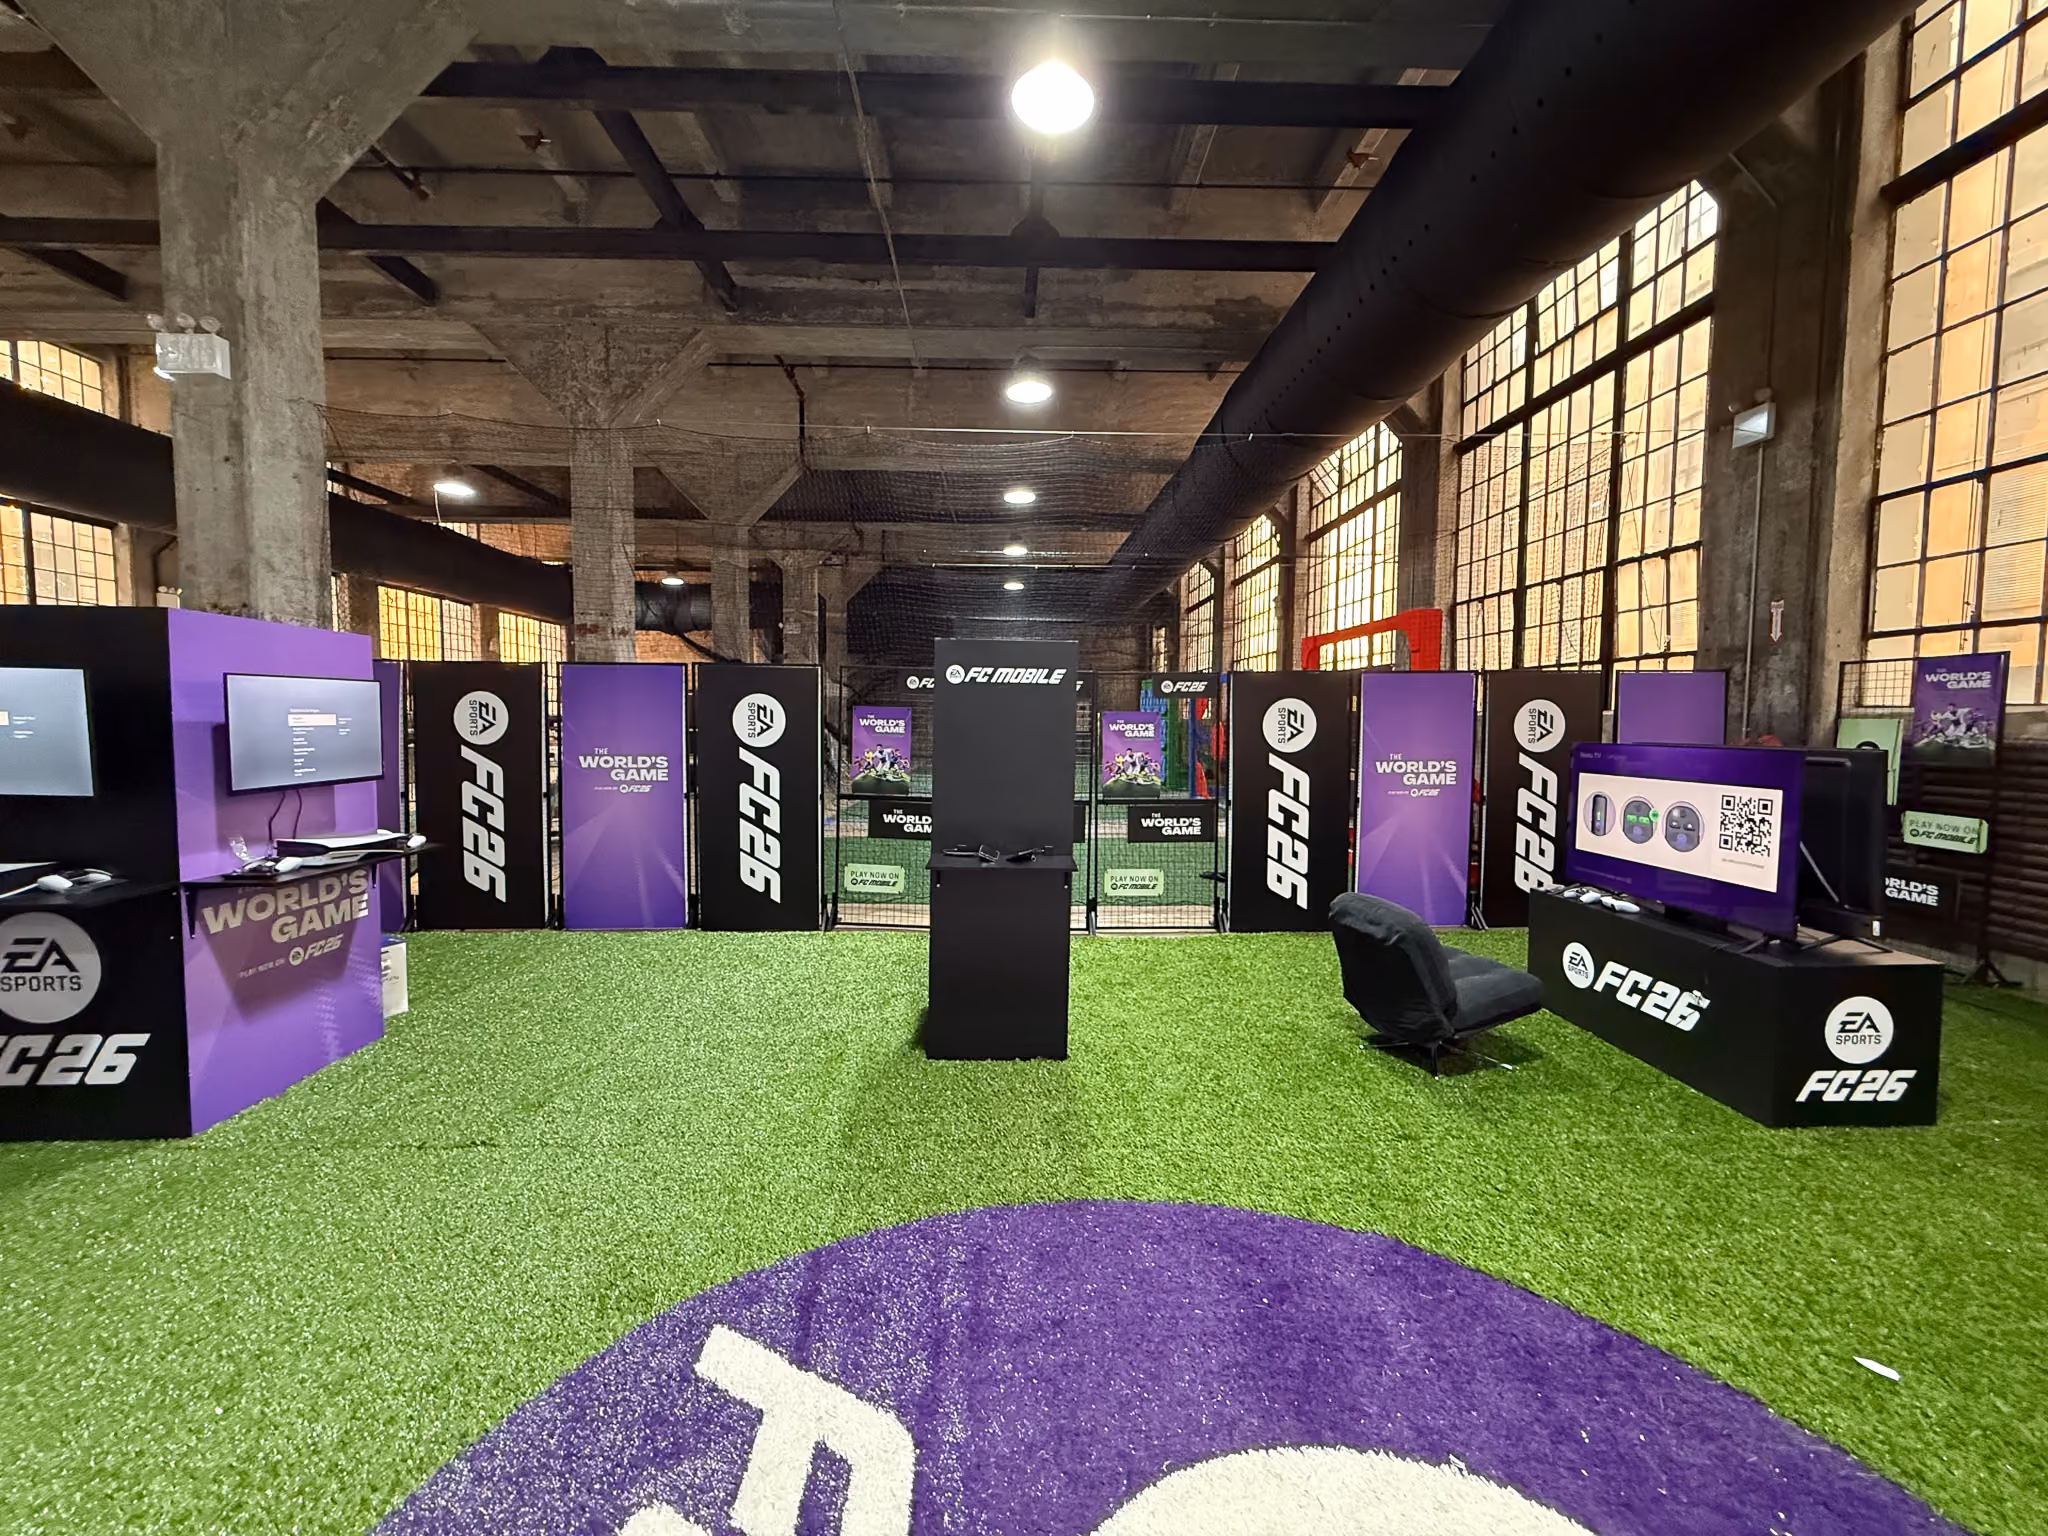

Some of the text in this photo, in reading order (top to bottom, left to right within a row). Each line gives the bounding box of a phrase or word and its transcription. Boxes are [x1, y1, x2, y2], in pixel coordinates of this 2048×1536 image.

[964, 667, 1067, 684] FC MOBILE
[1925, 672, 1992, 682] WORLD'S
[1173, 682, 1208, 692] FC26
[1946, 680, 1992, 689] GAME
[469, 700, 478, 736] SPORTS
[479, 701, 496, 735] EA
[748, 702, 756, 738] SPORTS
[757, 703, 774, 738] EA
[859, 719, 905, 727] WORLD'S
[1278, 708, 1286, 744] SPORTS
[1287, 708, 1304, 742] EA
[1528, 708, 1537, 744] SPORTS
[1537, 709, 1553, 742] EA
[874, 726, 905, 734] GAME
[1109, 723, 1155, 731] WORLD'S
[579, 756, 668, 768] WORLD'S
[1376, 761, 1456, 773] WORLD'S
[610, 768, 668, 781] GAME
[1403, 773, 1456, 785] GAME
[461, 744, 507, 903] FC26
[739, 746, 781, 904] FC26
[883, 814, 932, 824] WORLD
[1141, 818, 1201, 827] WORLD'S
[1909, 820, 1932, 829] PLAY
[1936, 823, 1960, 832] NOW
[1162, 826, 1201, 835] GAME
[1267, 752, 1310, 910] FC26
[1920, 831, 1935, 839] FC
[1885, 878, 1939, 895] RLD'S
[203, 869, 369, 934] WORLD'S
[1885, 888, 1938, 906] GAME
[271, 893, 369, 943] GAME
[1, 937, 80, 973] EA
[1568, 951, 1588, 971] EA
[1568, 964, 1589, 979] SPORTS
[0, 975, 82, 992] SPORTS
[1593, 961, 1711, 1031] FC26
[1837, 1012, 1880, 1033] EA
[1836, 1034, 1882, 1045] SPORTS
[0, 1033, 152, 1086] C26
[1795, 1069, 1918, 1102] FC26
